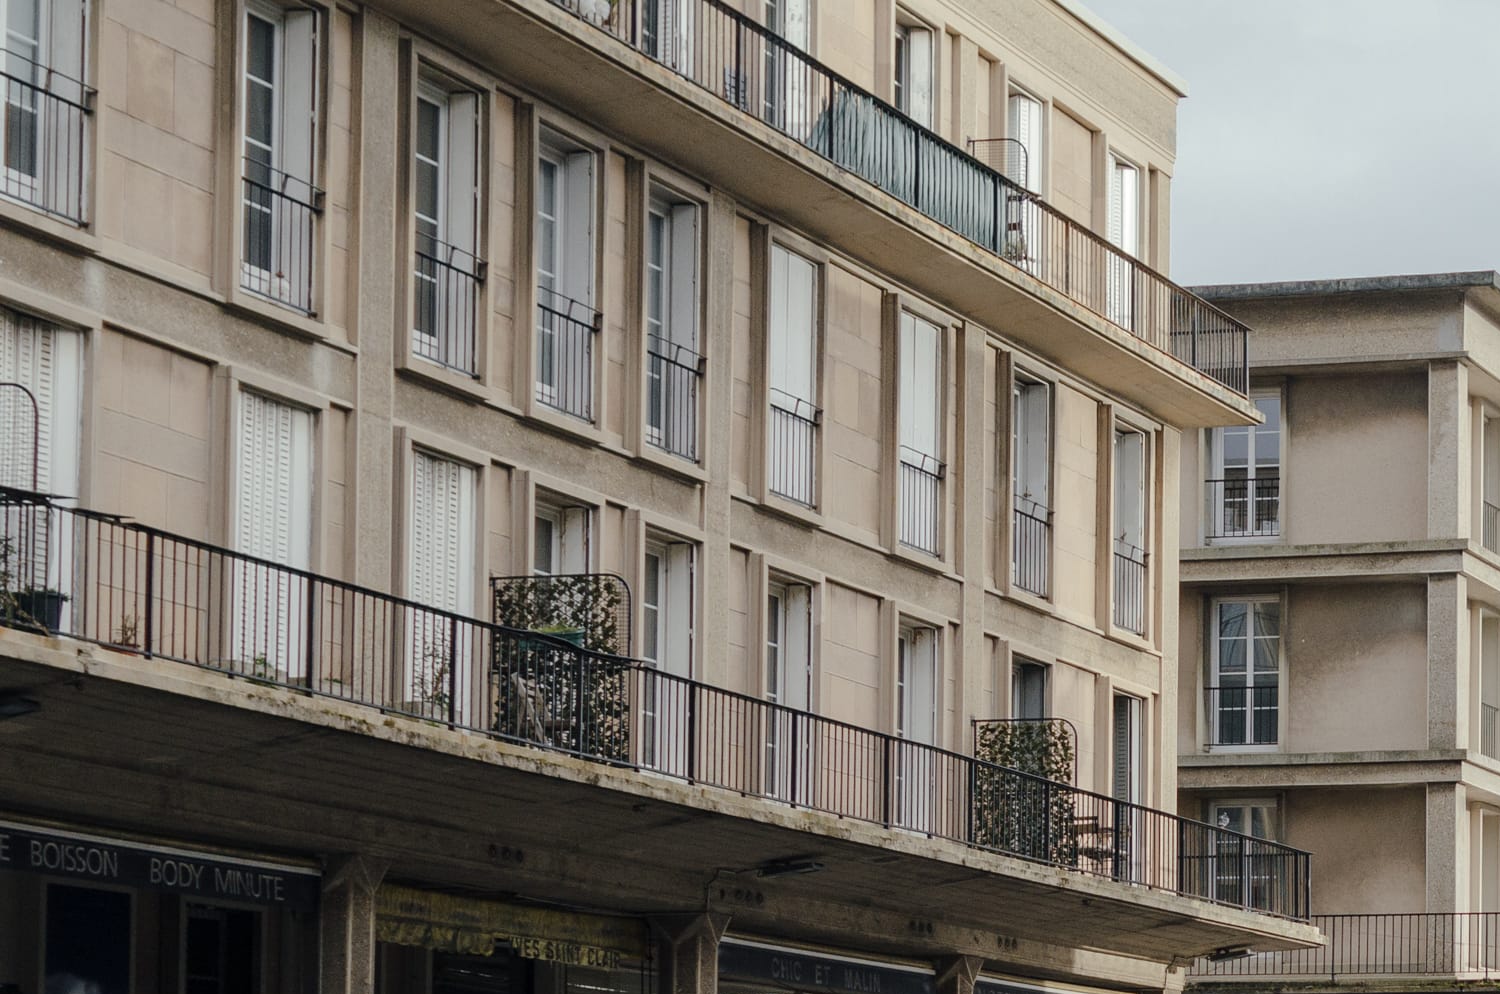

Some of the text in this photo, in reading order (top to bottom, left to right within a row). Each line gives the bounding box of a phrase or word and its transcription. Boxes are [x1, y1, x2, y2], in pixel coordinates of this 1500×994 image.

[30, 840, 118, 877] BOISSON
[150, 857, 204, 889] BODY
[215, 867, 285, 901] MINUTE
[771, 957, 881, 993] CHIC ET MALIN
